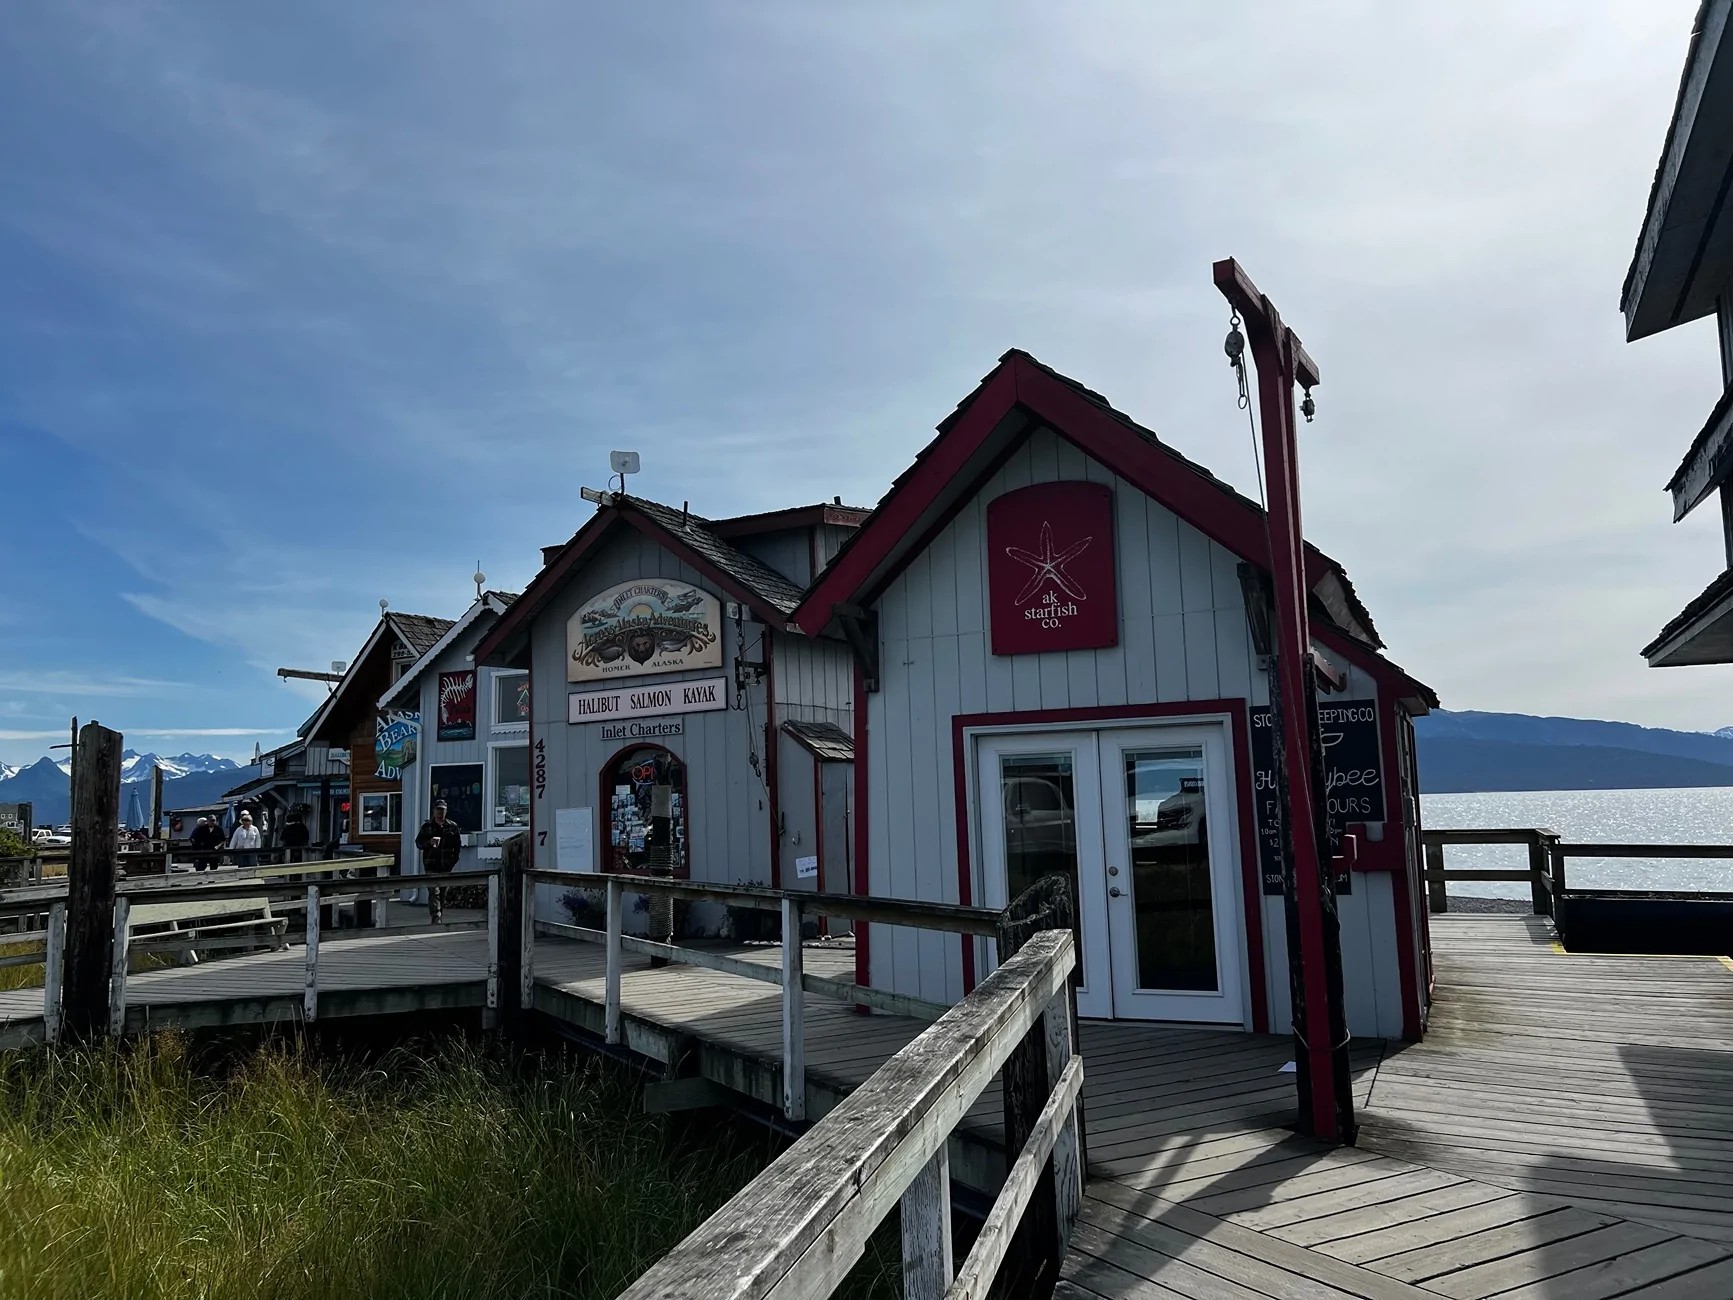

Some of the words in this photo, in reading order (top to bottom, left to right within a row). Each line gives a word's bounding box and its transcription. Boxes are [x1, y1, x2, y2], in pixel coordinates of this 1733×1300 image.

[613, 589, 634, 609] INLET
[634, 585, 669, 604] CHARTERS
[1042, 590, 1059, 604] ak
[1024, 601, 1079, 620] starfish
[580, 624, 616, 652] Across
[615, 614, 648, 631] Alaska
[648, 610, 709, 637] Adventures
[1041, 617, 1062, 629] co.
[602, 664, 631, 673] HOMER
[651, 658, 684, 668] ALASKA
[578, 695, 620, 715] HALIBUT
[630, 689, 672, 710] SALMON
[683, 685, 717, 705] KAYAK
[378, 724, 417, 753] BEAR
[601, 725, 626, 739] Inlet
[629, 721, 681, 736] Charters
[535, 740, 545, 799] 4287
[631, 766, 653, 780] OP
[1328, 797, 1372, 815] OURS
[538, 831, 547, 846] 7
